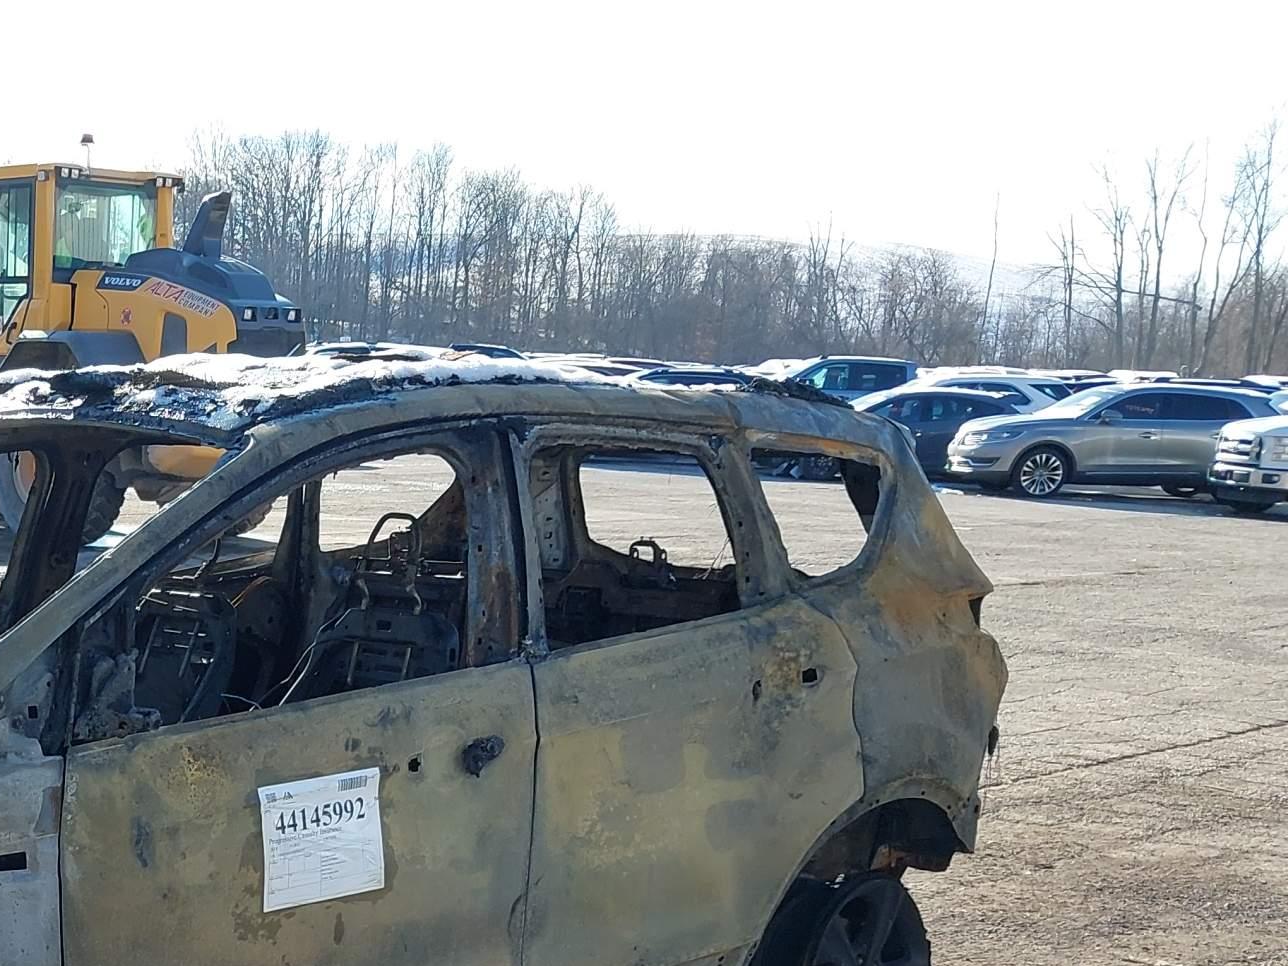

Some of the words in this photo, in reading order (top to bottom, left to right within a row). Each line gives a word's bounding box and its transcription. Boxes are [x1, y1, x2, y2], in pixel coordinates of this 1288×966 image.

[103, 275, 142, 287] VOLVO
[144, 280, 186, 303] ALTA
[177, 297, 215, 317] COMPANY
[184, 290, 220, 311] EQUIPMENT
[275, 796, 366, 835] 44145992
